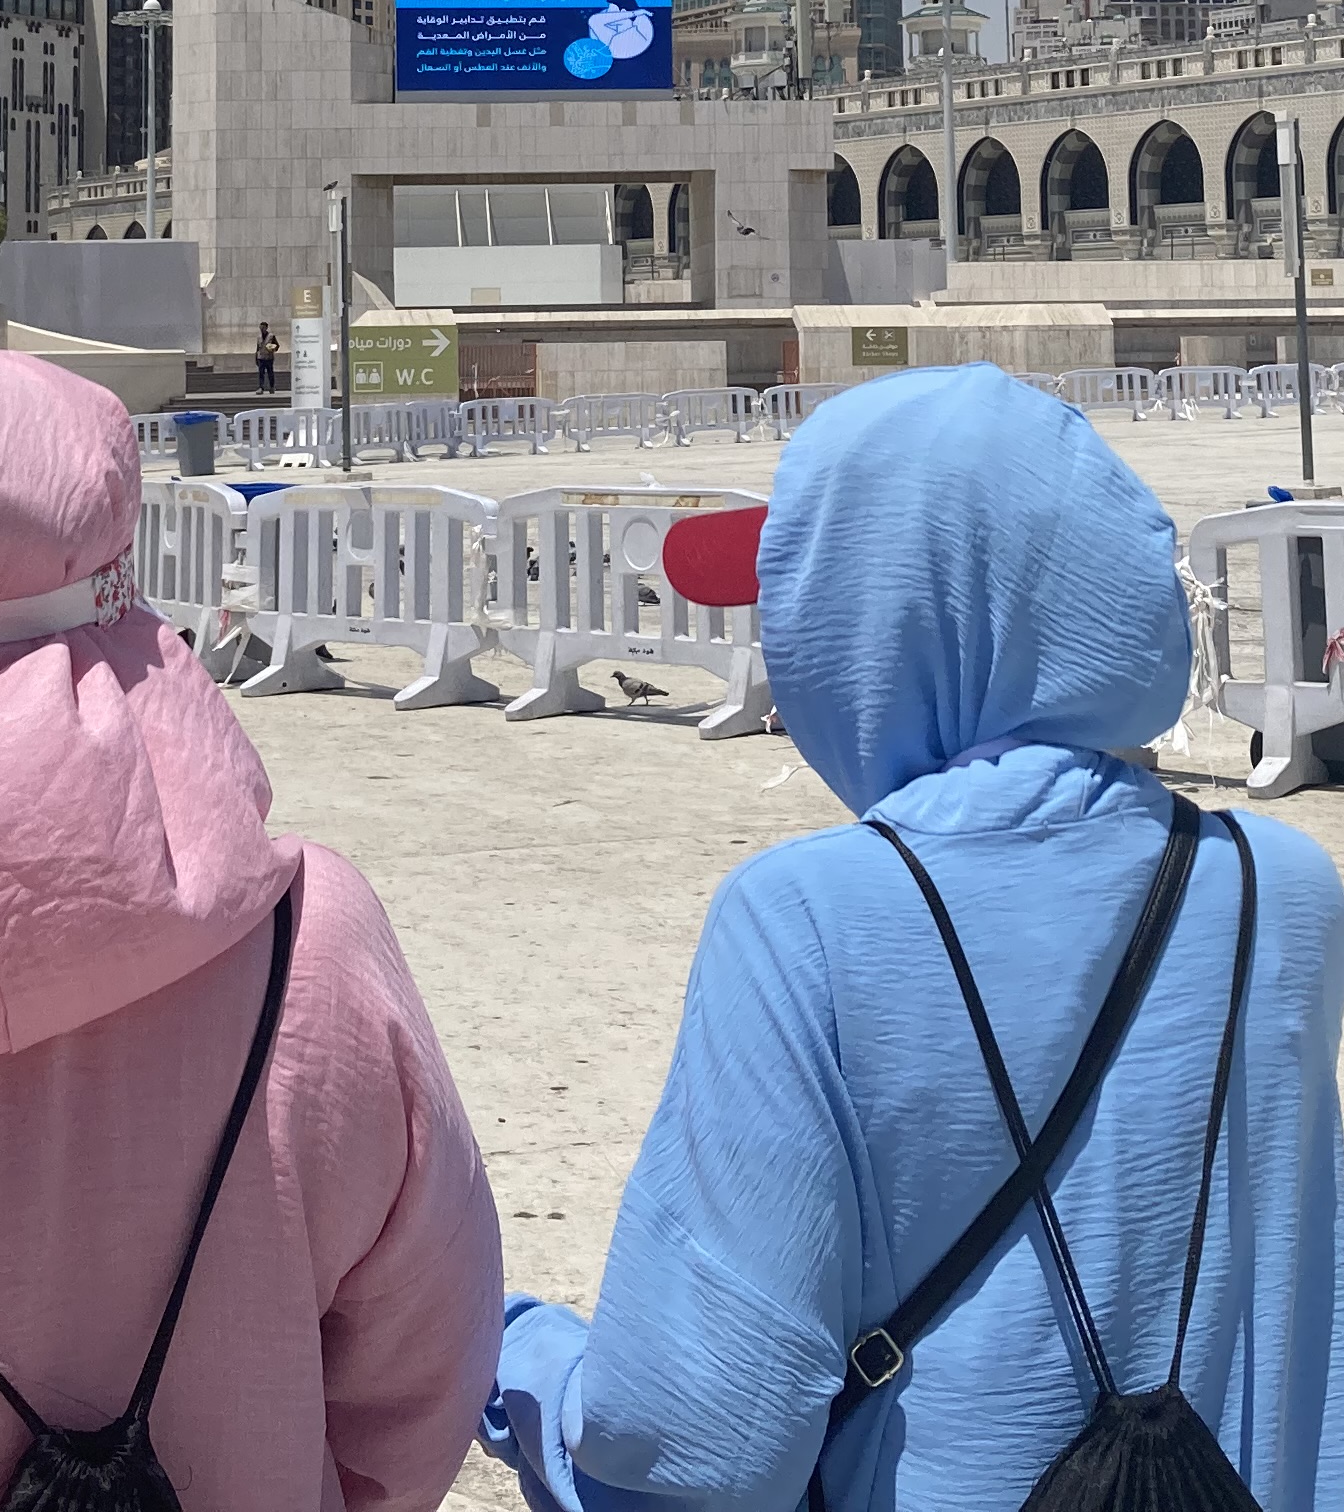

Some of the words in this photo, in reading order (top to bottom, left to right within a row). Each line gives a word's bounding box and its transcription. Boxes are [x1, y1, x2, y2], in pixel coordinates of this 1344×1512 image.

[417, 15, 449, 26] الوقاية
[451, 15, 485, 26] تدابير
[486, 15, 526, 26] بتطبيق
[528, 16, 546, 26] قم
[417, 31, 470, 42] المعدية
[472, 30, 517, 41] الأمراض
[519, 32, 546, 41] من
[304, 290, 312, 303] E
[377, 337, 412, 351] دورات
[396, 368, 434, 386] W.C
